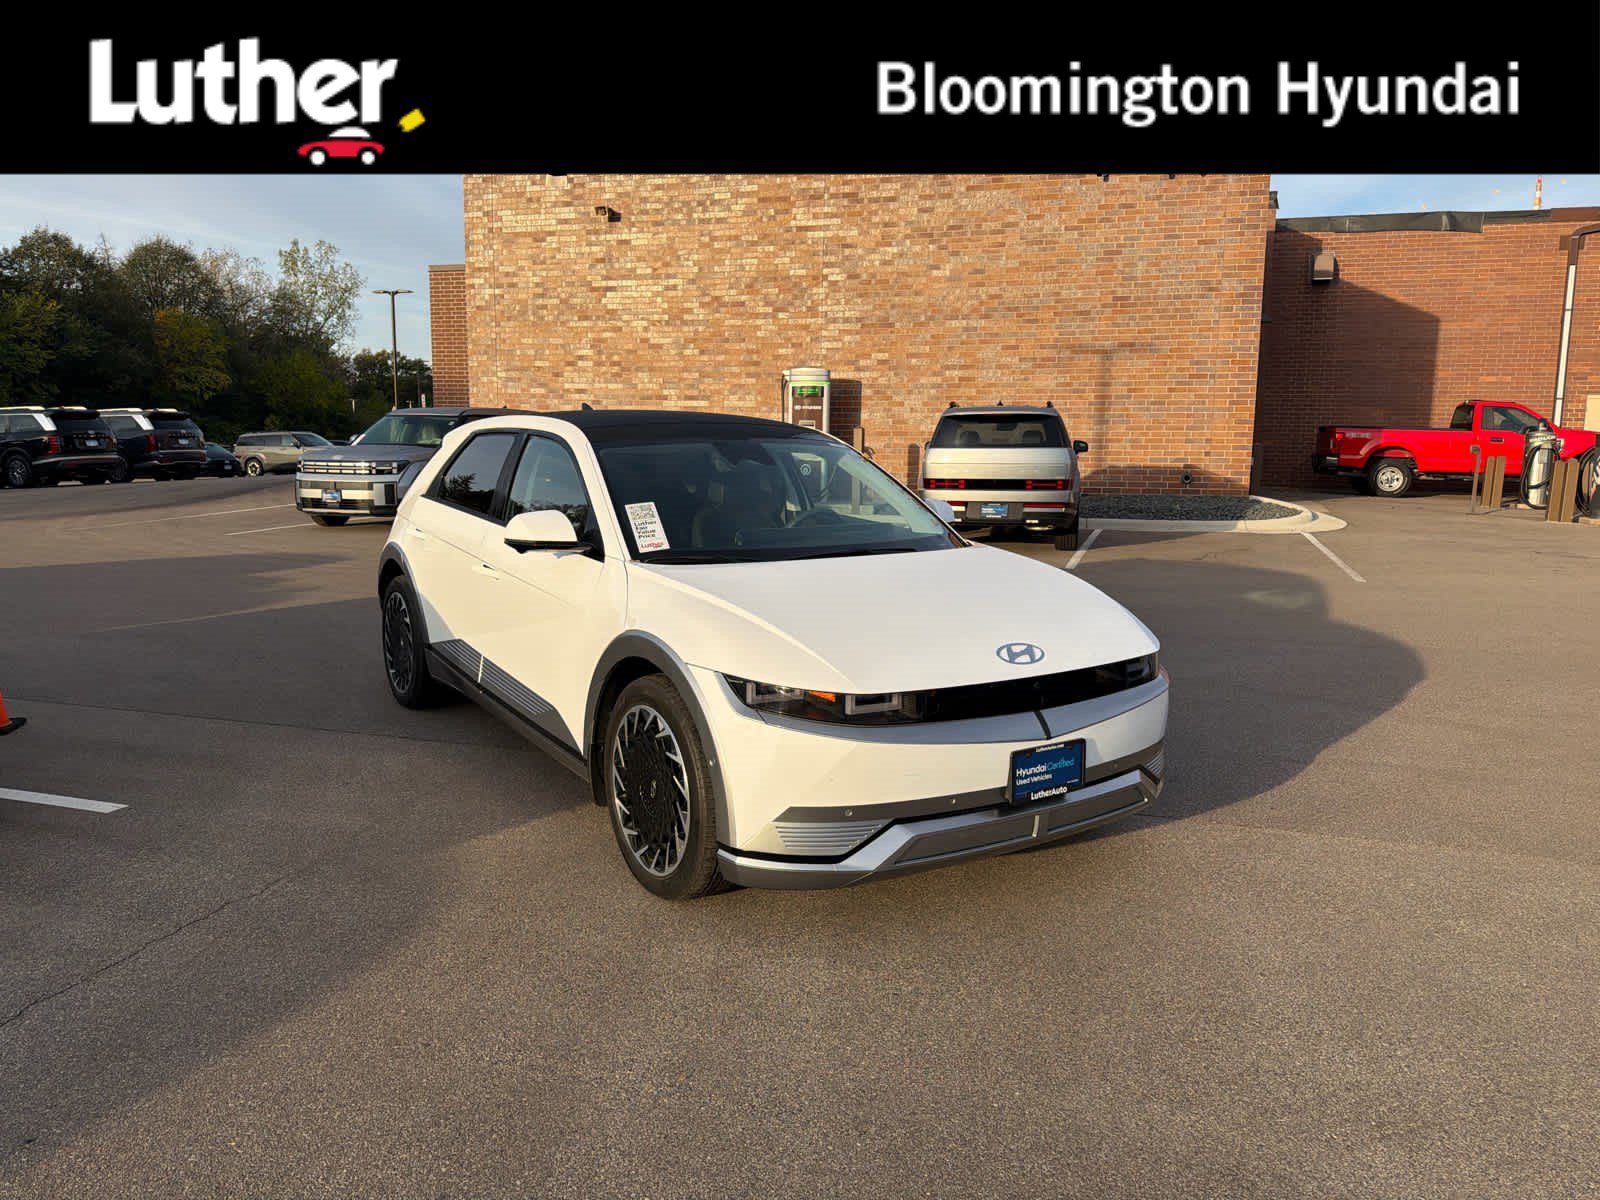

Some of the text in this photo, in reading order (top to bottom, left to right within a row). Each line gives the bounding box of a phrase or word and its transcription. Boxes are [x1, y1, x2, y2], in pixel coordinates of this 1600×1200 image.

[1016, 757, 1074, 777] Hyundai Certified
[1016, 778, 1031, 786] Used
[1030, 786, 1068, 801] LutherAuto
